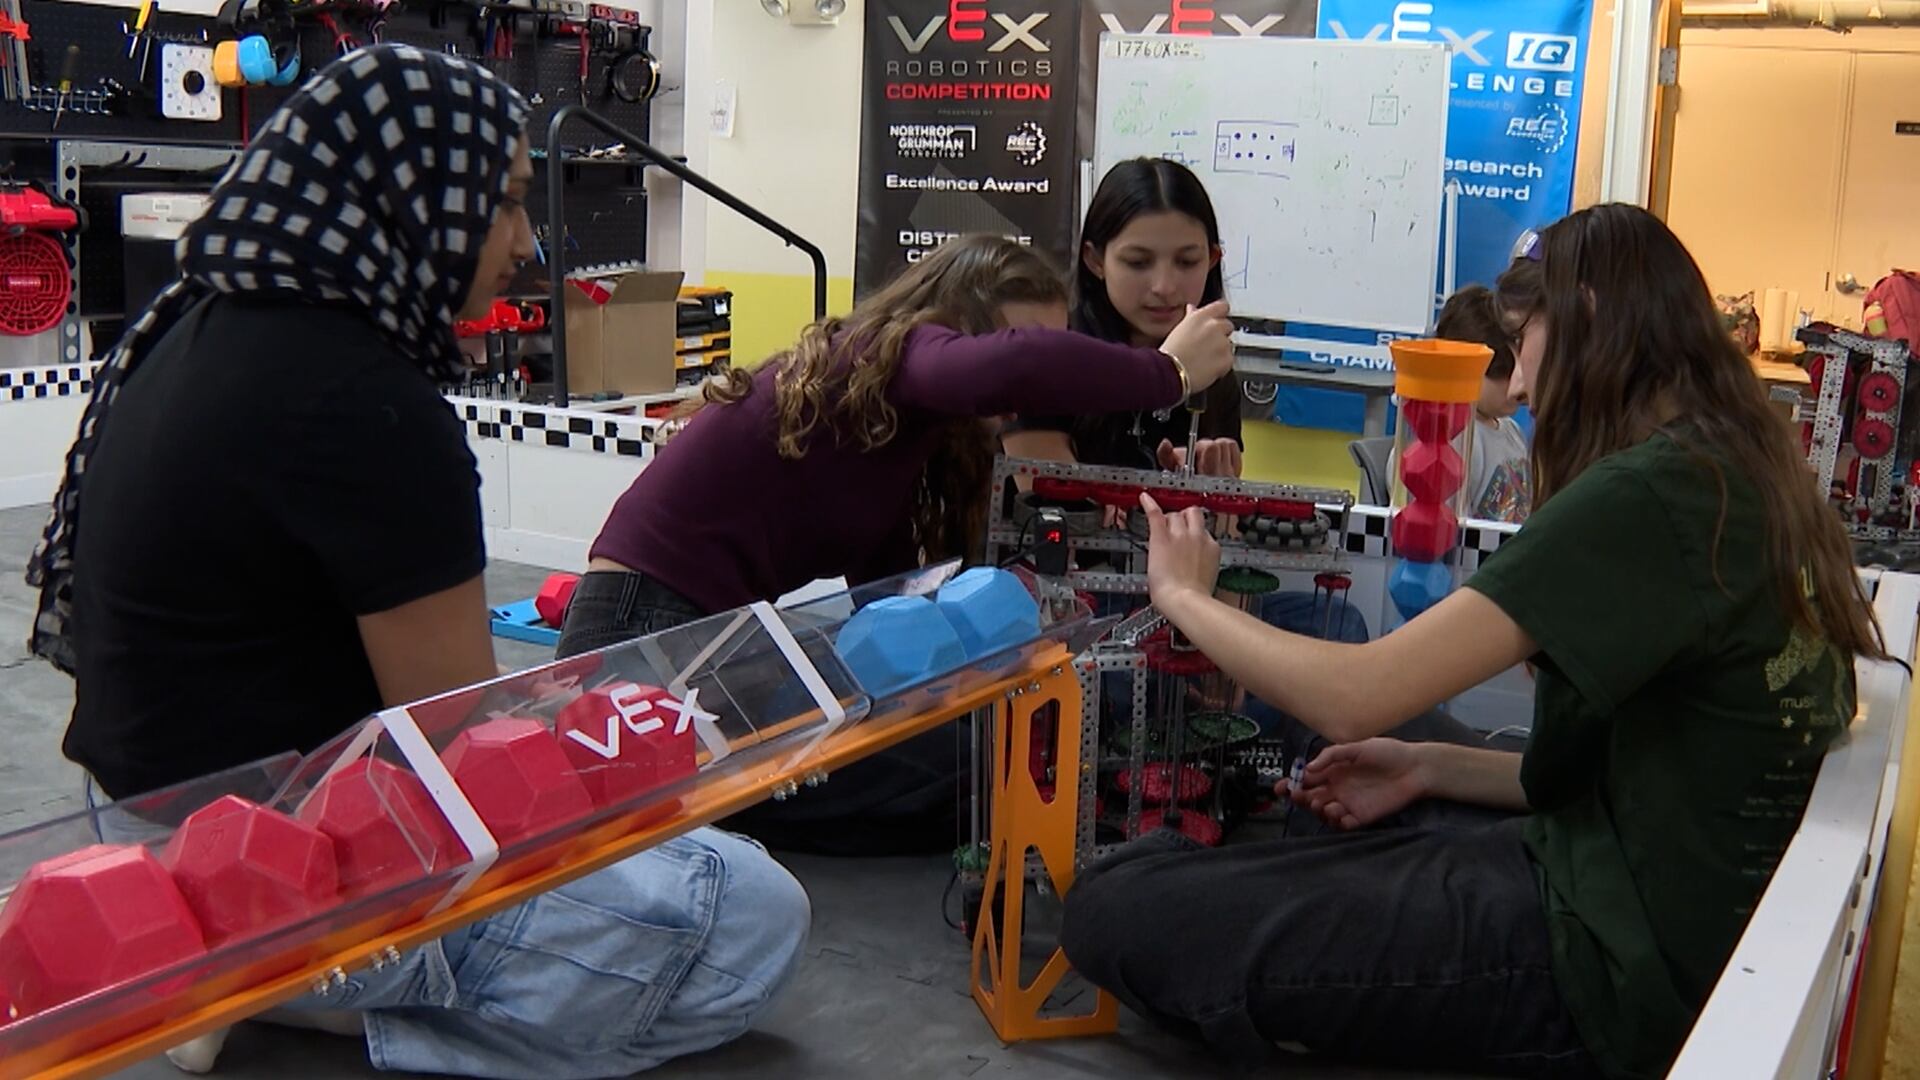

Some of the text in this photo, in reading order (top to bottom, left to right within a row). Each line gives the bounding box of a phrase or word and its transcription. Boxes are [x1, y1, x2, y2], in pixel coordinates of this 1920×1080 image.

[887, 0, 1051, 53] VEX
[1513, 38, 1571, 65] IQ
[886, 60, 1051, 76] ROBOTICS
[886, 83, 1051, 100] COMPETITION
[1450, 72, 1573, 97] ENGE
[890, 125, 955, 137] NORTHROP
[898, 137, 964, 150] GRUMMAN
[886, 174, 1049, 193] Excellence Award
[565, 683, 720, 759] VEX
